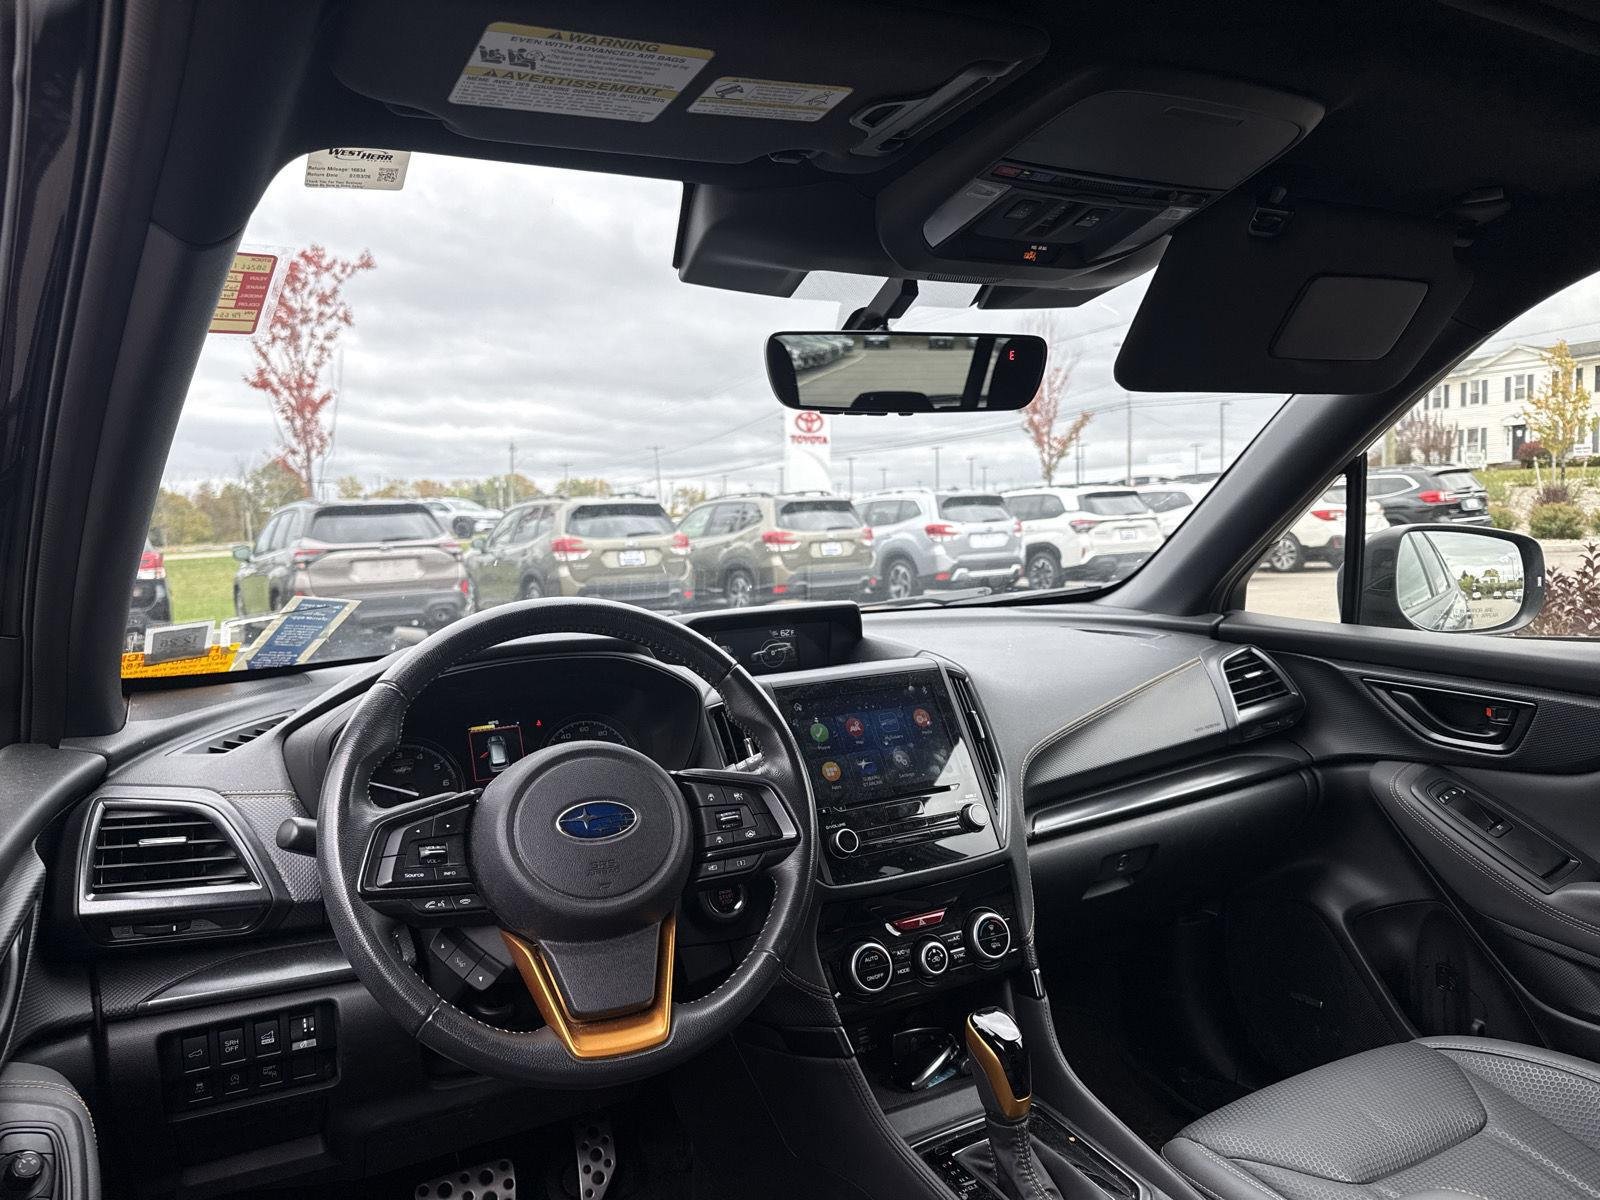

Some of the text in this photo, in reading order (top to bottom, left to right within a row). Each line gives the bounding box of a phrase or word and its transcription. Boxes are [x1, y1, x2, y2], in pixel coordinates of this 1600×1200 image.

[567, 32, 661, 52] WARNING
[510, 36, 687, 64] EVEN WITH ADVANCED AIR BAGS
[501, 70, 661, 97] AVERTISSEMENT
[790, 434, 828, 445] TOYOTA
[864, 954, 879, 962] AUTO
[866, 972, 884, 982] ON/OFF
[224, 1045, 240, 1053] OFF
